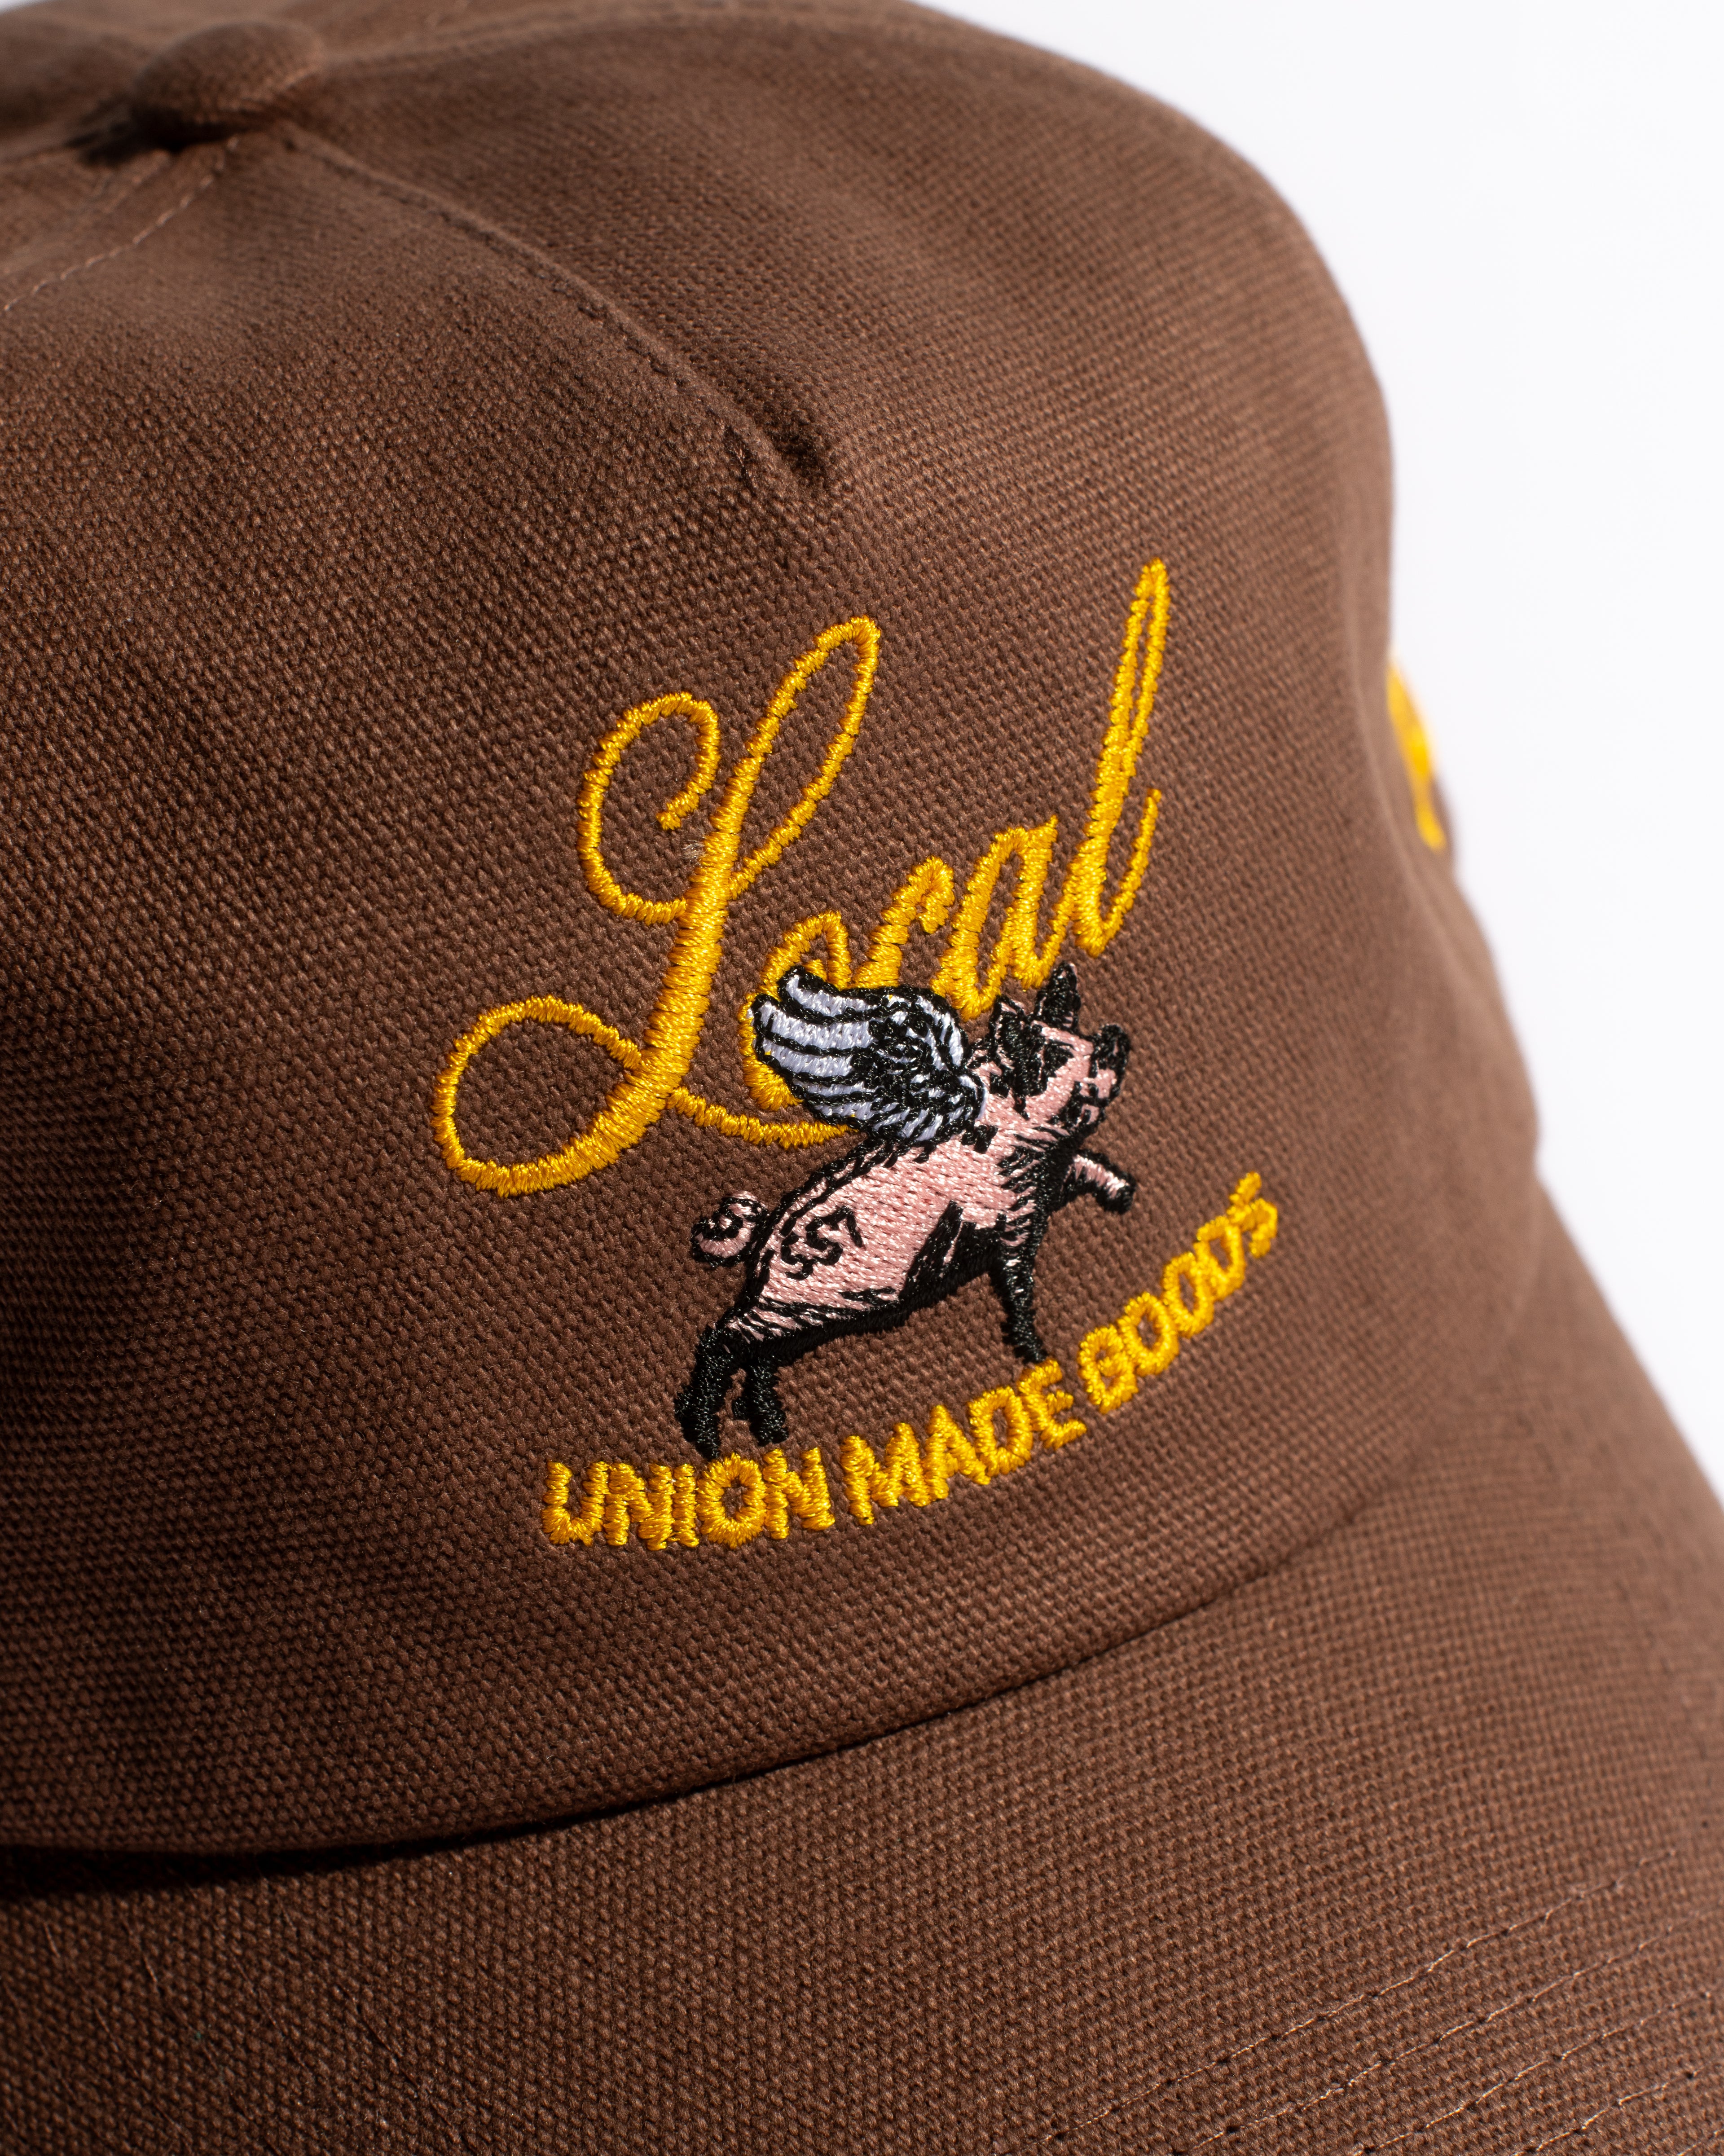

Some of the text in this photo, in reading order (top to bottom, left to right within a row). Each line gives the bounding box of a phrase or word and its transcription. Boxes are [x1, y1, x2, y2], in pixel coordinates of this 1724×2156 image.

[542, 1171, 1279, 1550] UNION MADE GOODS
